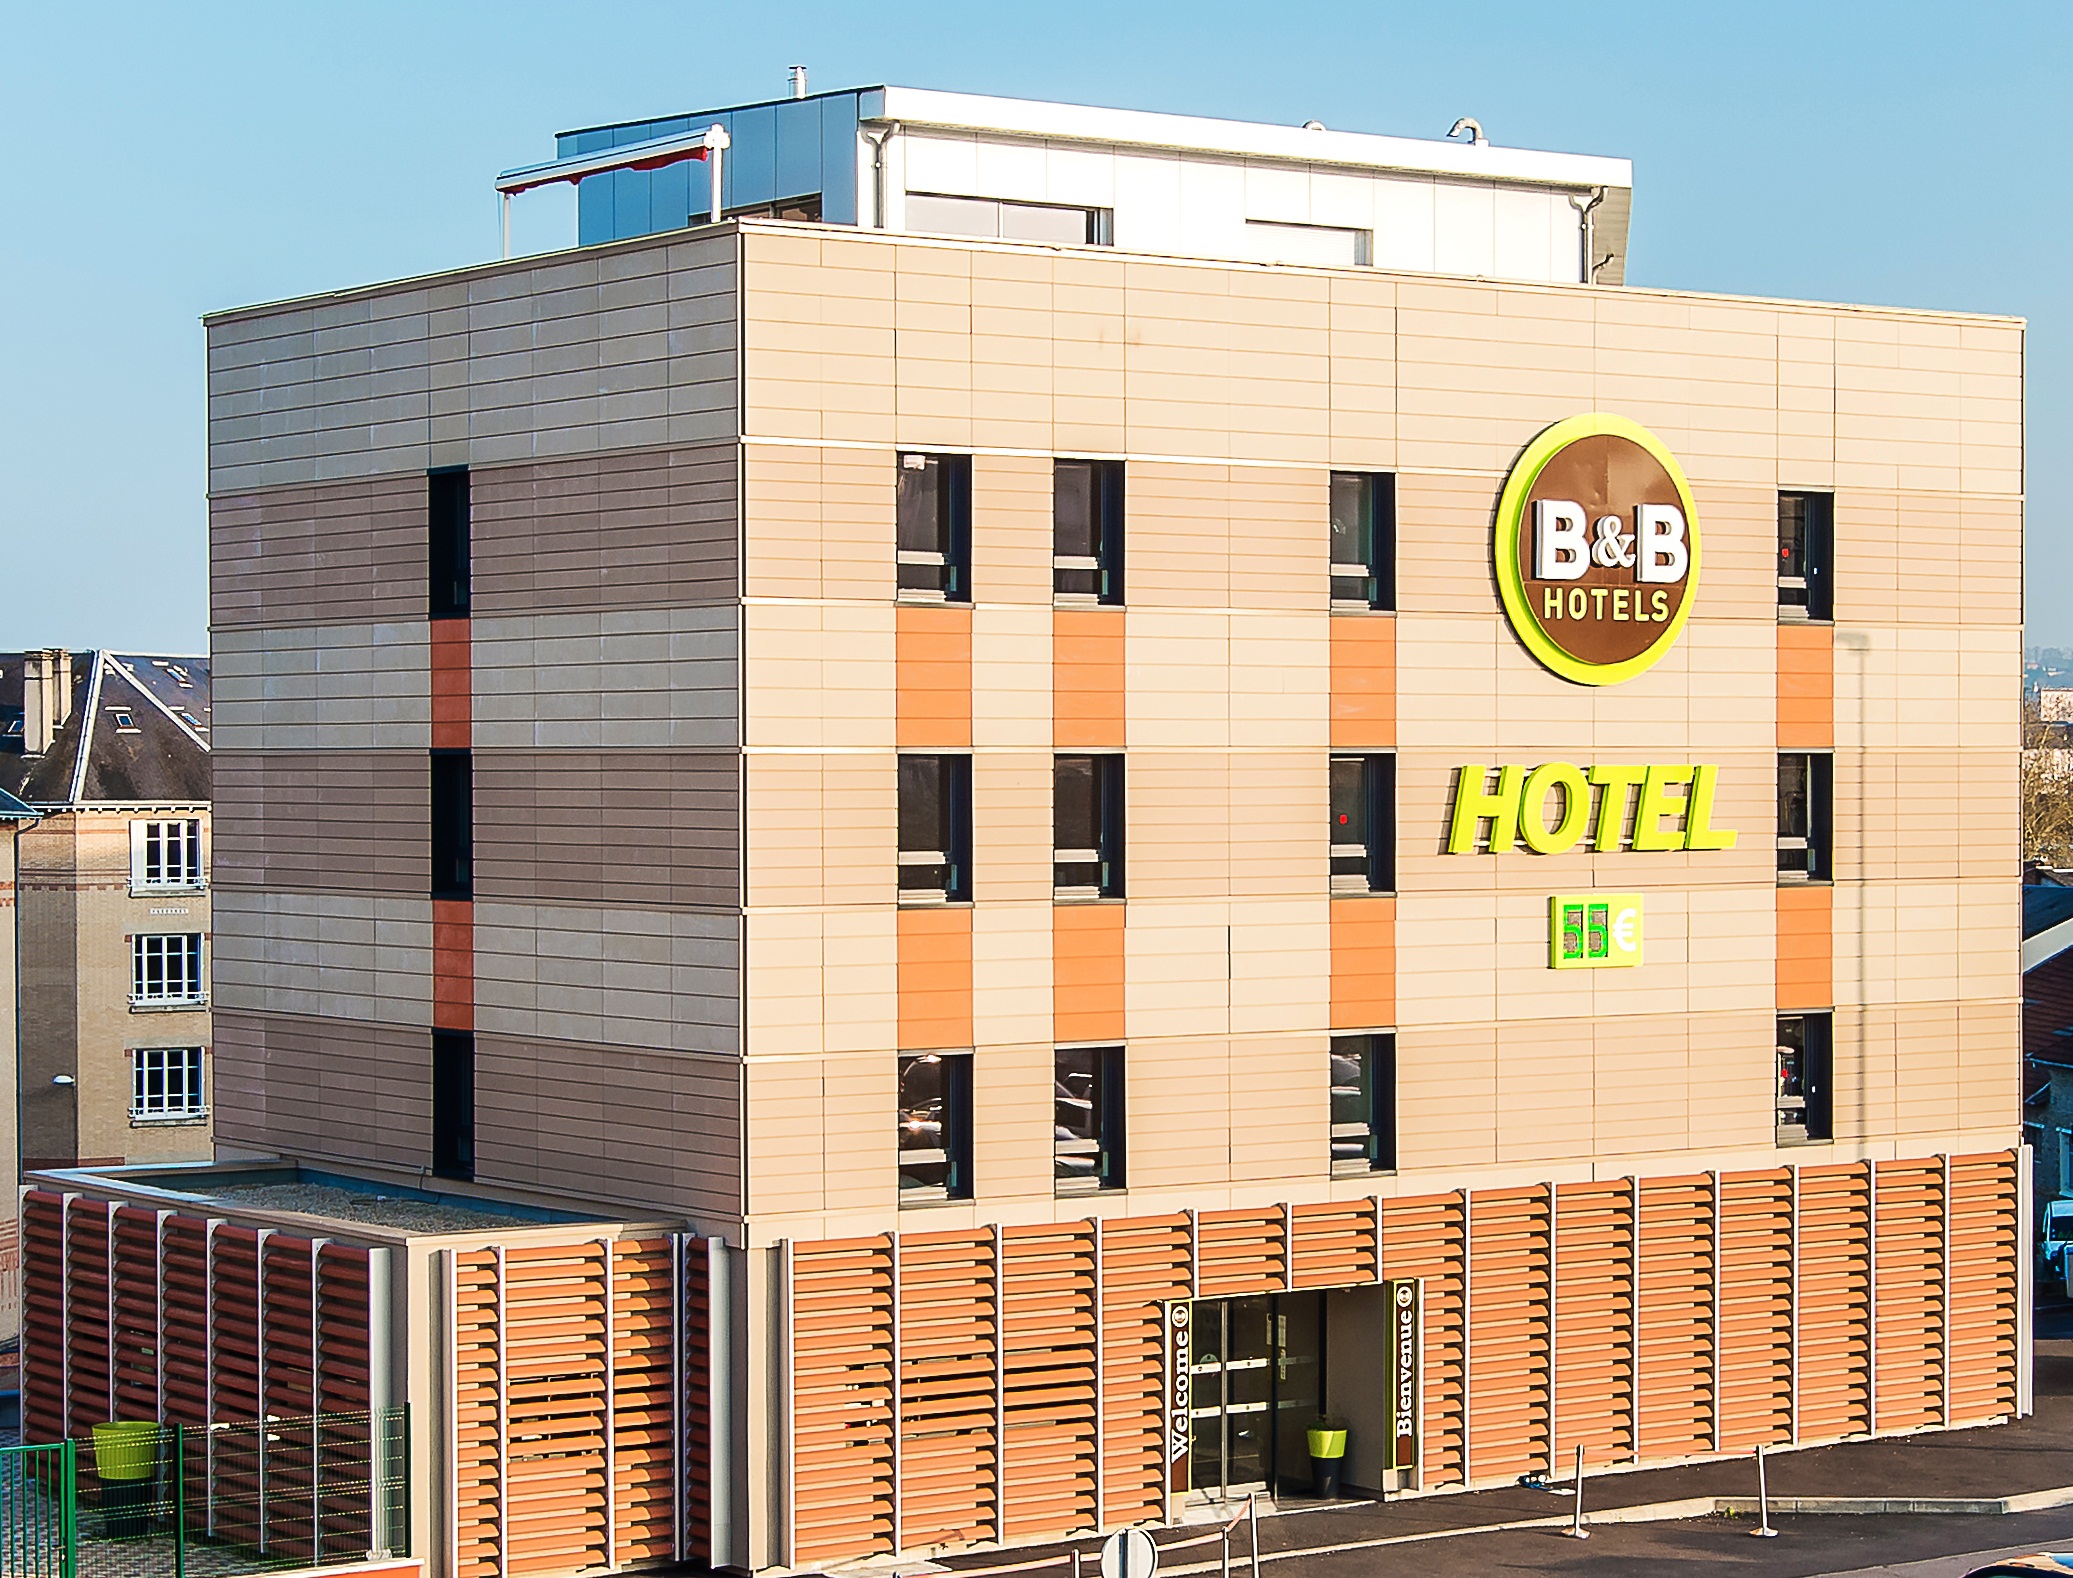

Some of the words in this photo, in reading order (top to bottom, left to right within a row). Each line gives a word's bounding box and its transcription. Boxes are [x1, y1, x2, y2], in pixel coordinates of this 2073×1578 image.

[1534, 499, 1688, 583] B&B
[1544, 587, 1670, 622] HOTELS
[1449, 761, 1738, 854] HOTEL
[1171, 1330, 1189, 1463] Welcome
[1396, 1310, 1413, 1438] Bienvenue
